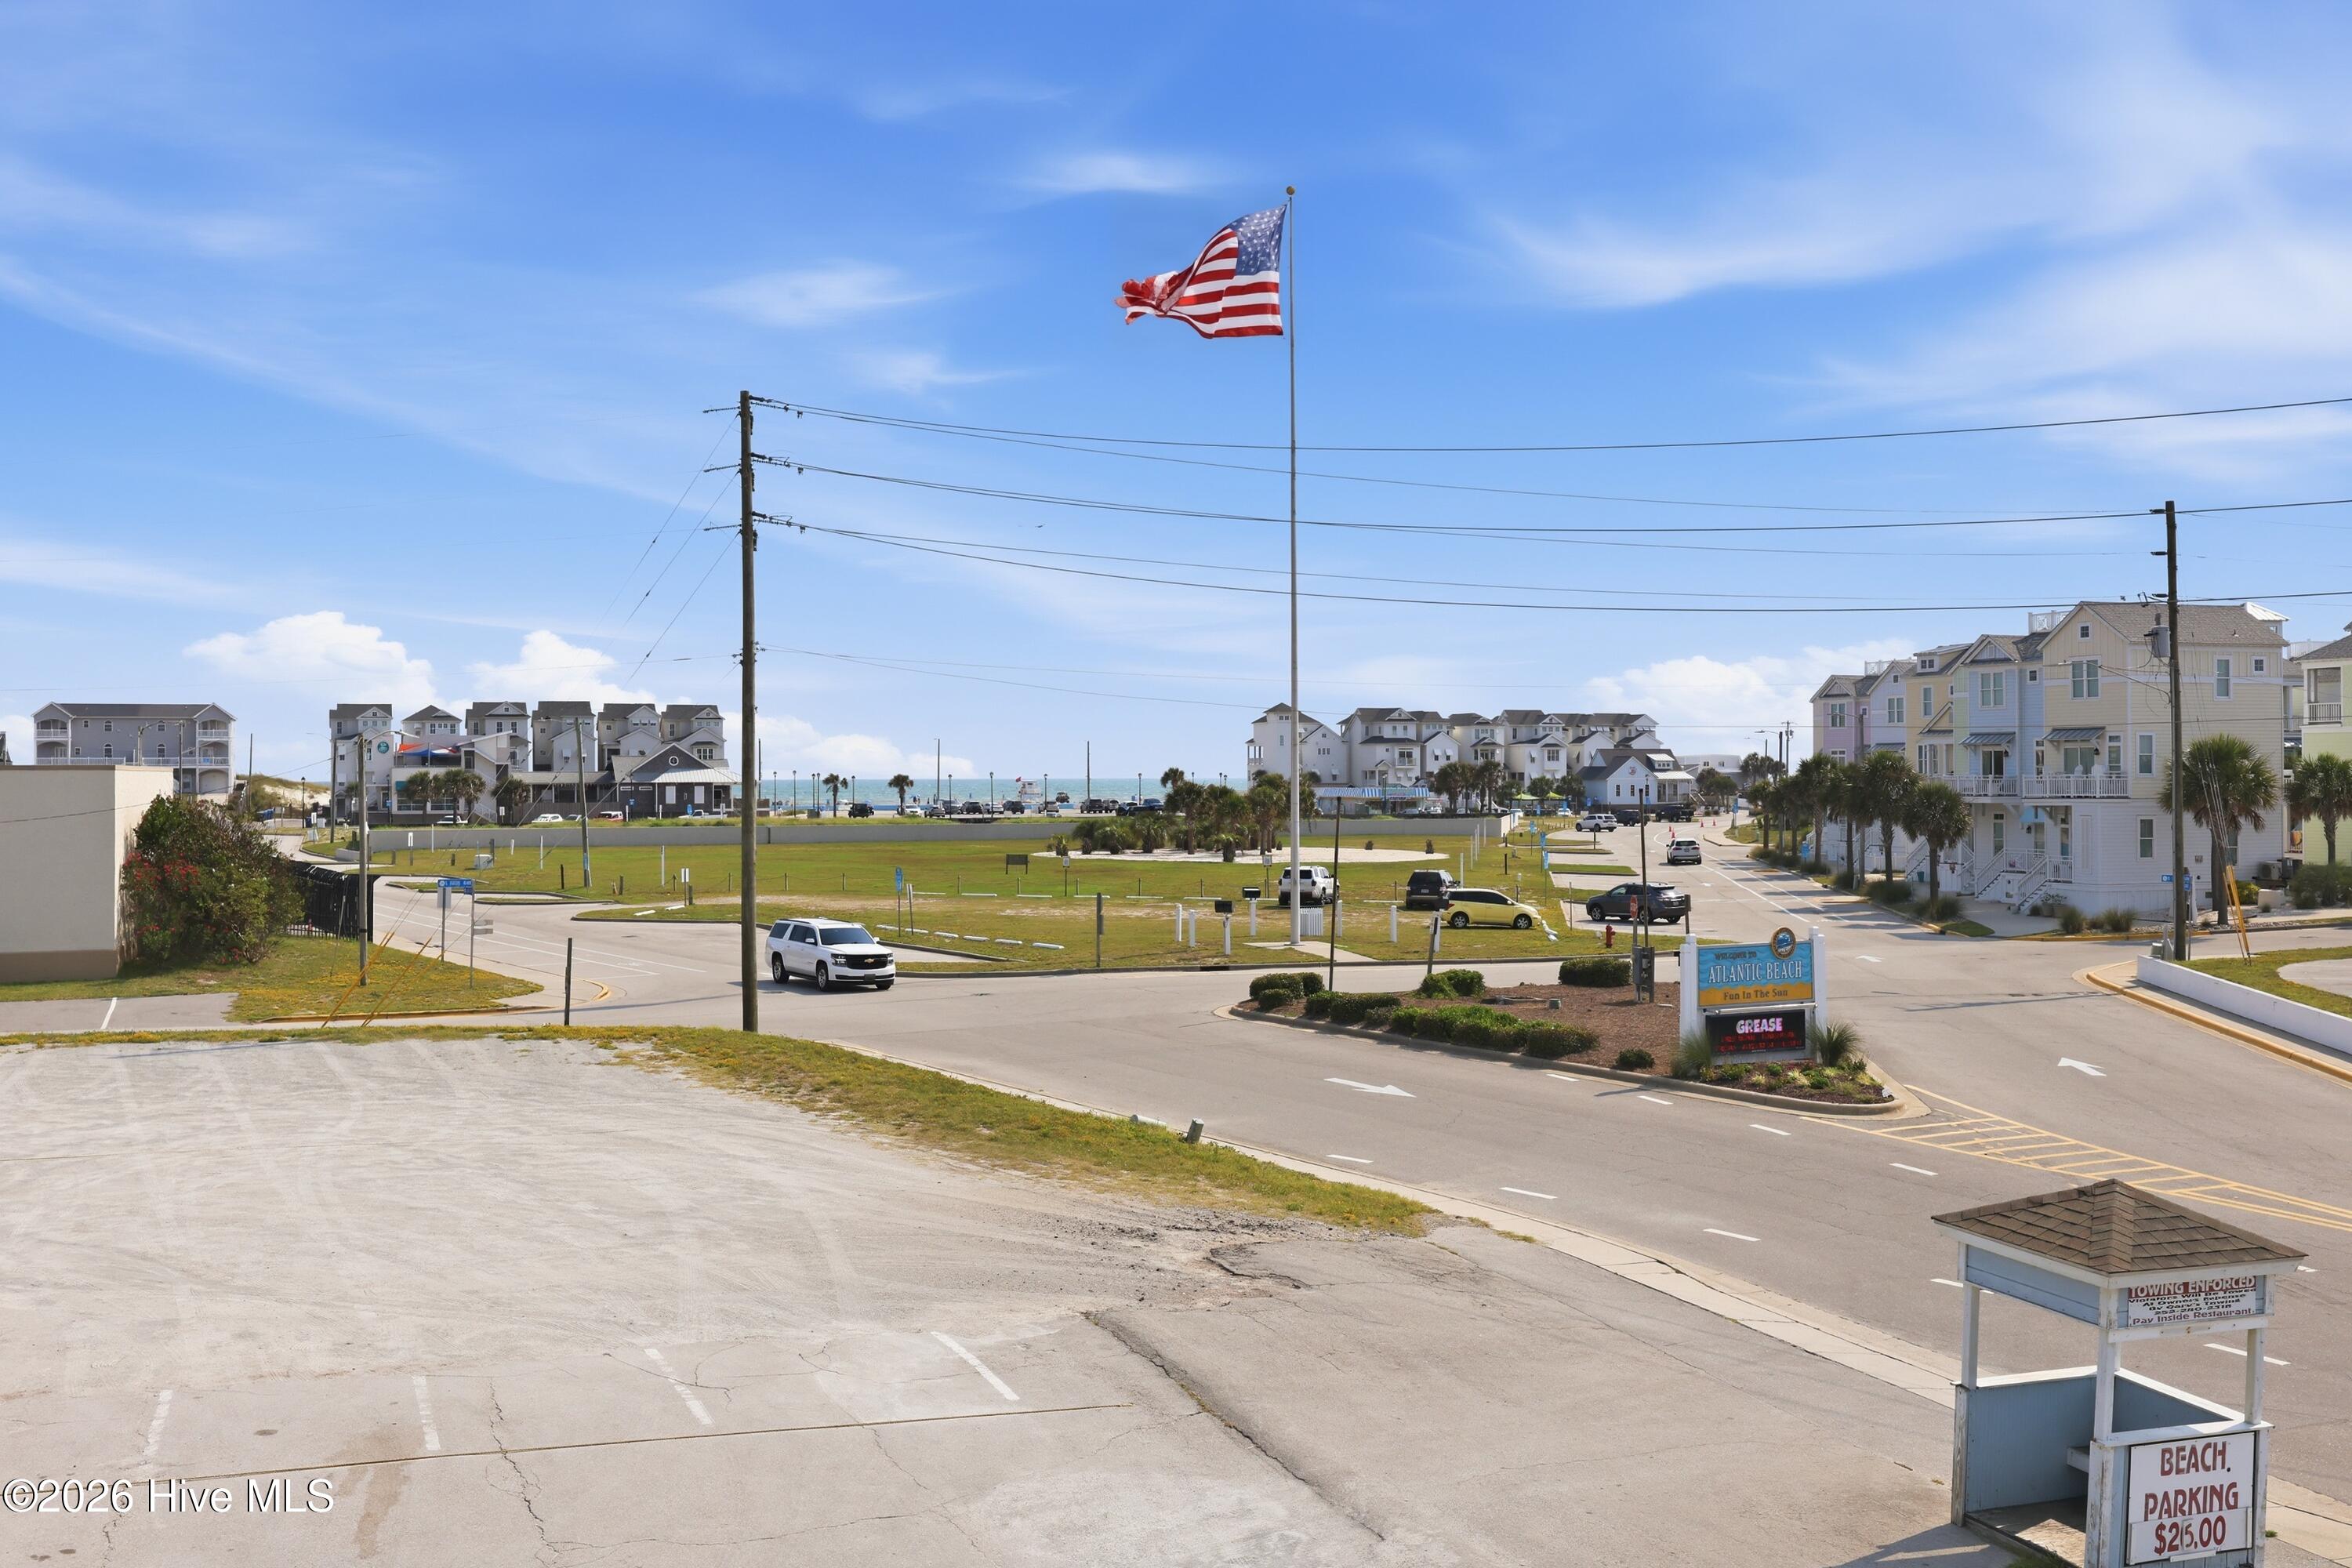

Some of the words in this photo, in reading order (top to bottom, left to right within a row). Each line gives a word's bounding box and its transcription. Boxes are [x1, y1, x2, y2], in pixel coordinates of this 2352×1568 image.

[1708, 963, 1762, 983] ATLANTIC
[1766, 960, 1802, 979] BEACH
[1724, 992, 1740, 1000] Fun
[1742, 990, 1751, 1000] In
[1754, 989, 1769, 998] The
[1773, 988, 1788, 997] Sun
[1736, 1018, 1783, 1034] GREASE
[2130, 1283, 2184, 1298] TOWING
[2188, 1276, 2255, 1293] ENFORCED
[2158, 1313, 2189, 1323] Inside
[2194, 1308, 2251, 1319] Restaurant
[2161, 1441, 2227, 1476] BEACH
[2143, 1482, 2238, 1522] PARKING
